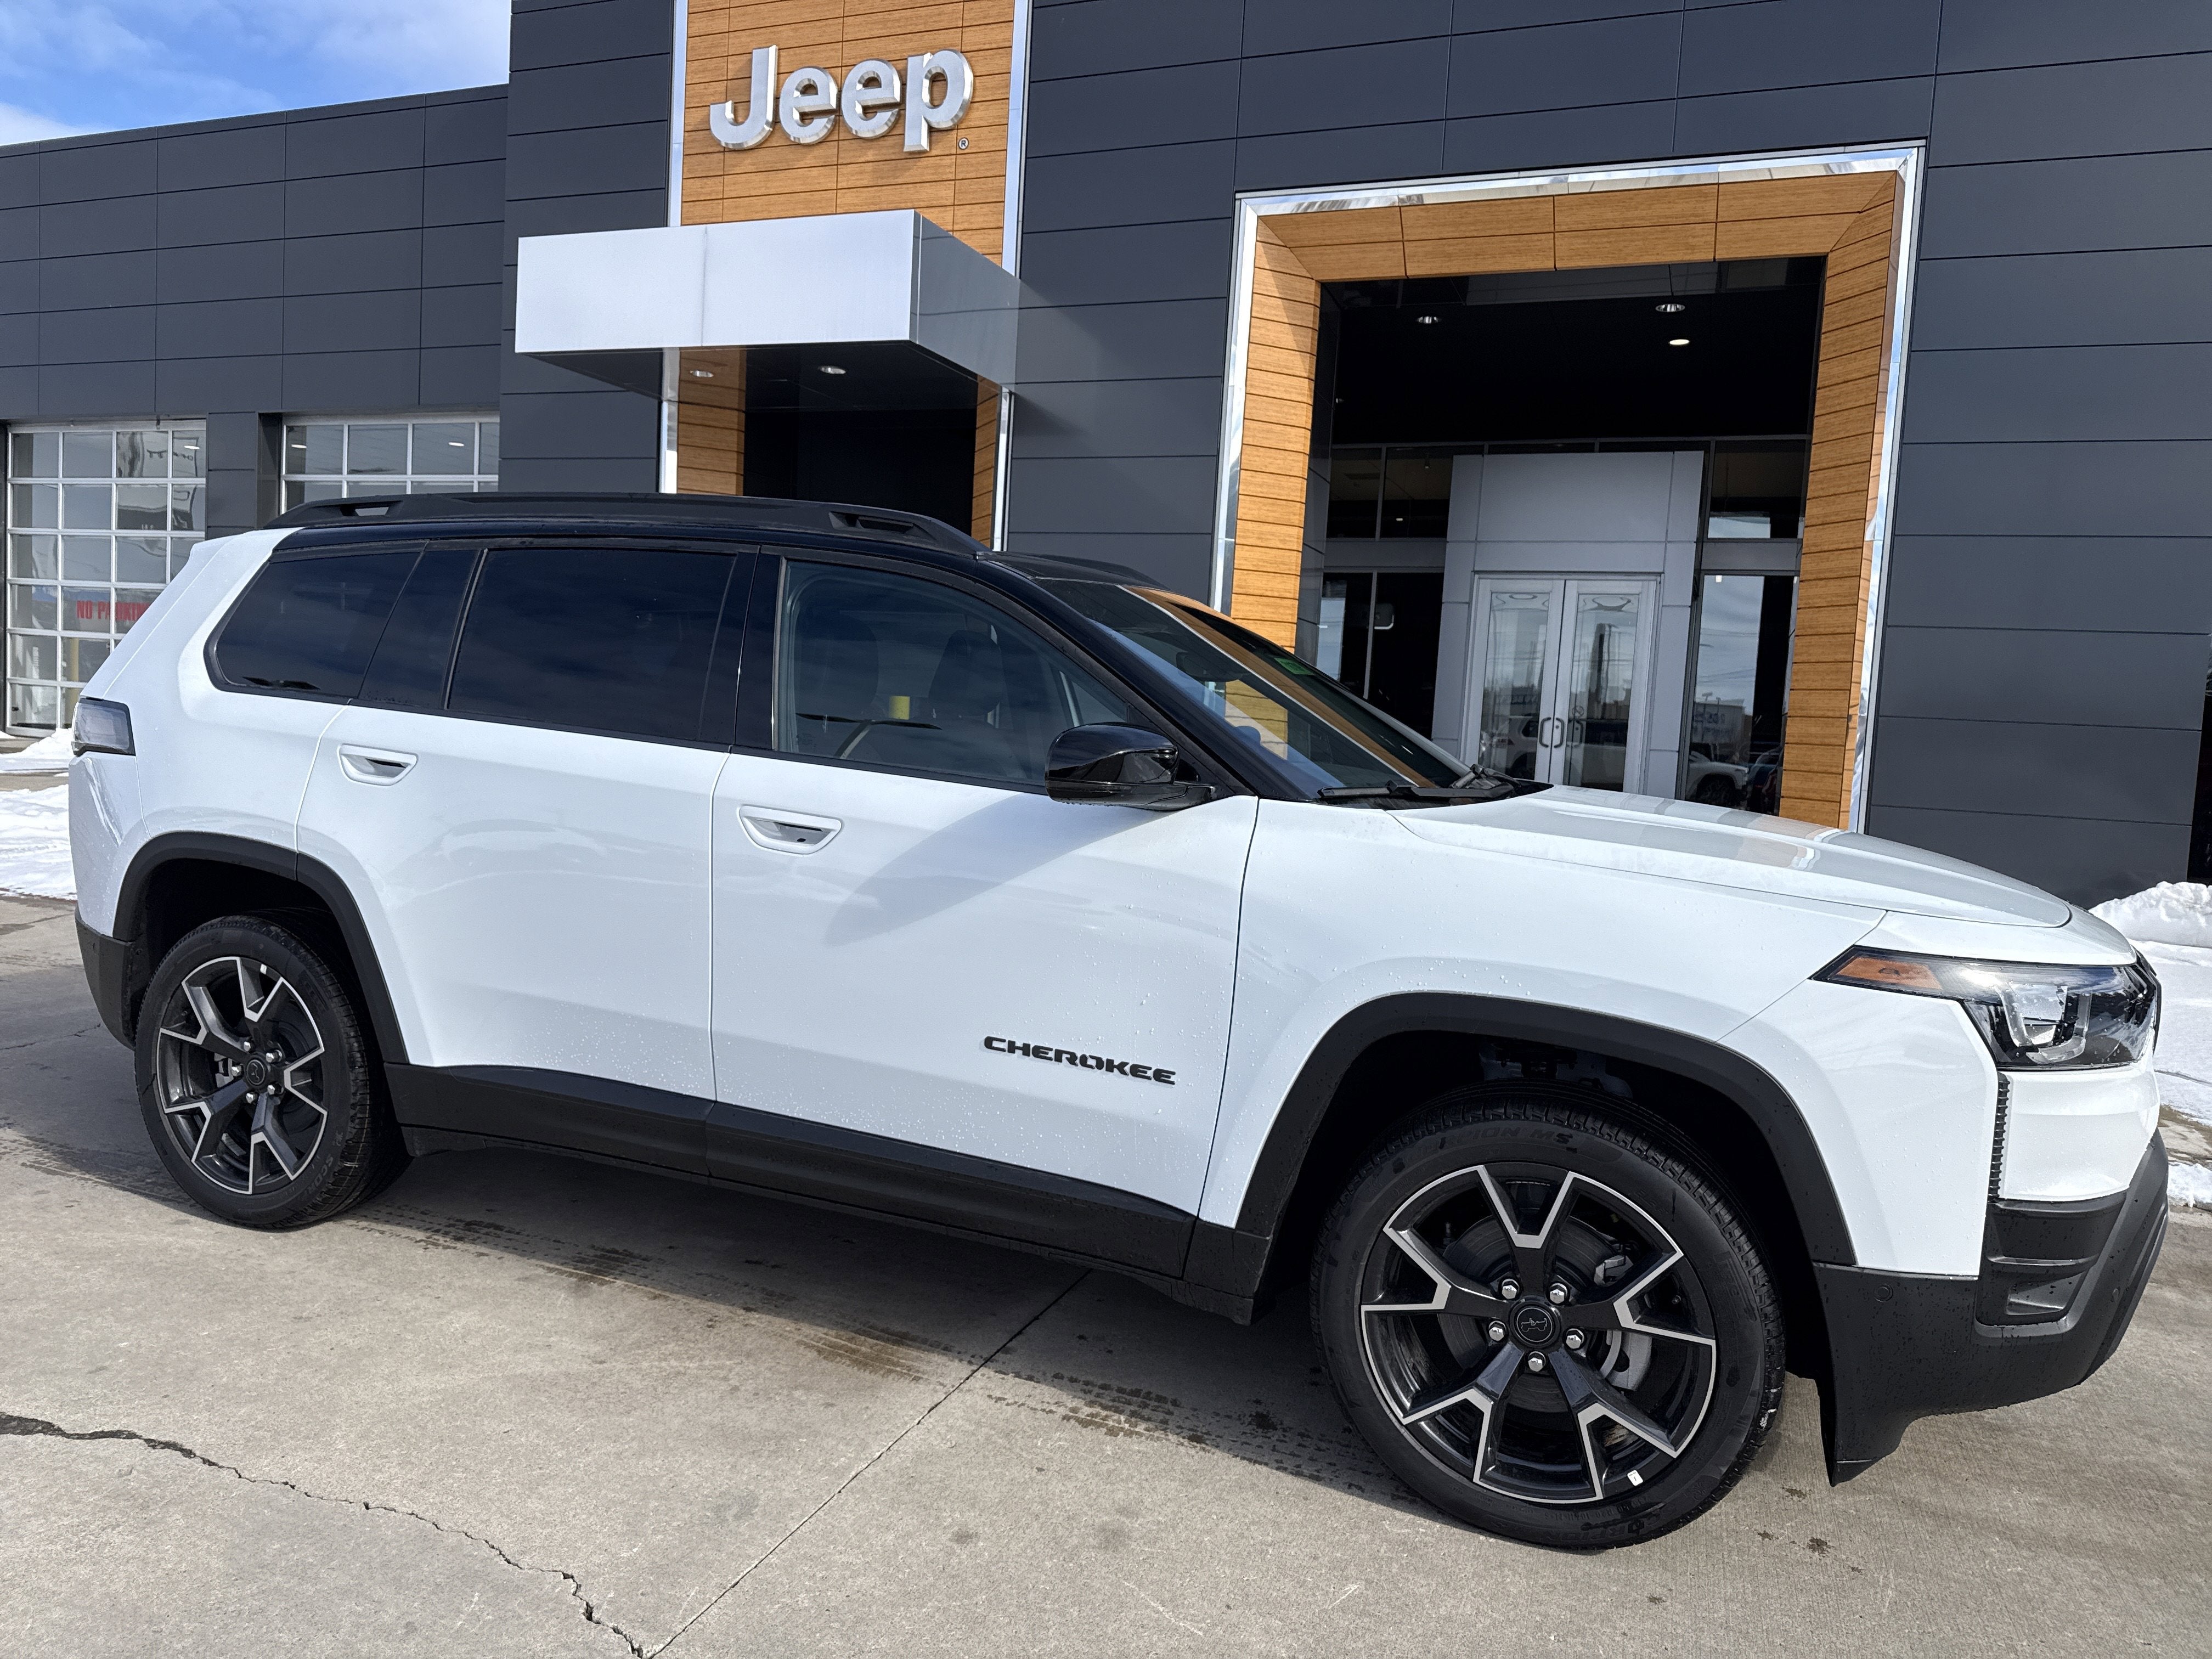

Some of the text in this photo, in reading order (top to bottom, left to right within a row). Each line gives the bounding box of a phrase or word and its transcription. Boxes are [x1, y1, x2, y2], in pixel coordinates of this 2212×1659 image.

[710, 45, 973, 151] Jeep
[77, 600, 150, 621] NO PARKIN
[984, 1036, 1176, 1085] CHEROKEE
